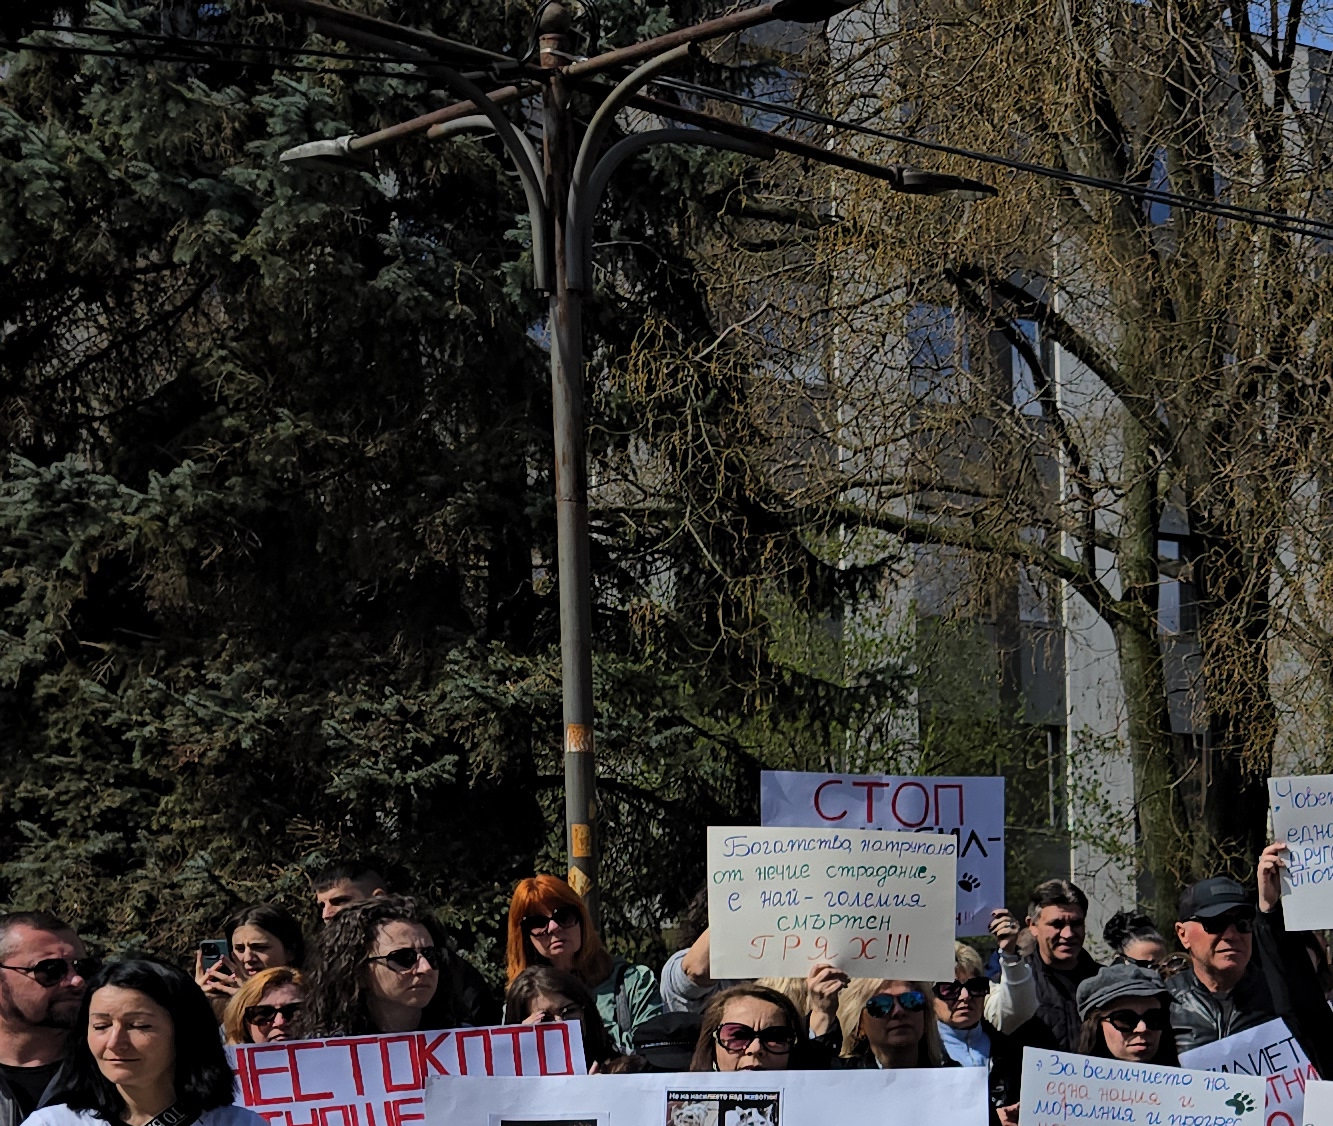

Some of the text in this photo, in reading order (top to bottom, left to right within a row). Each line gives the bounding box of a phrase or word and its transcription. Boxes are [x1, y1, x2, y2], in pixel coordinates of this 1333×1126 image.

[813, 780, 965, 828] СТОП
[713, 870, 744, 884] от
[1083, 1058, 1231, 1091] величието на
[1099, 1085, 1162, 1106] нация
